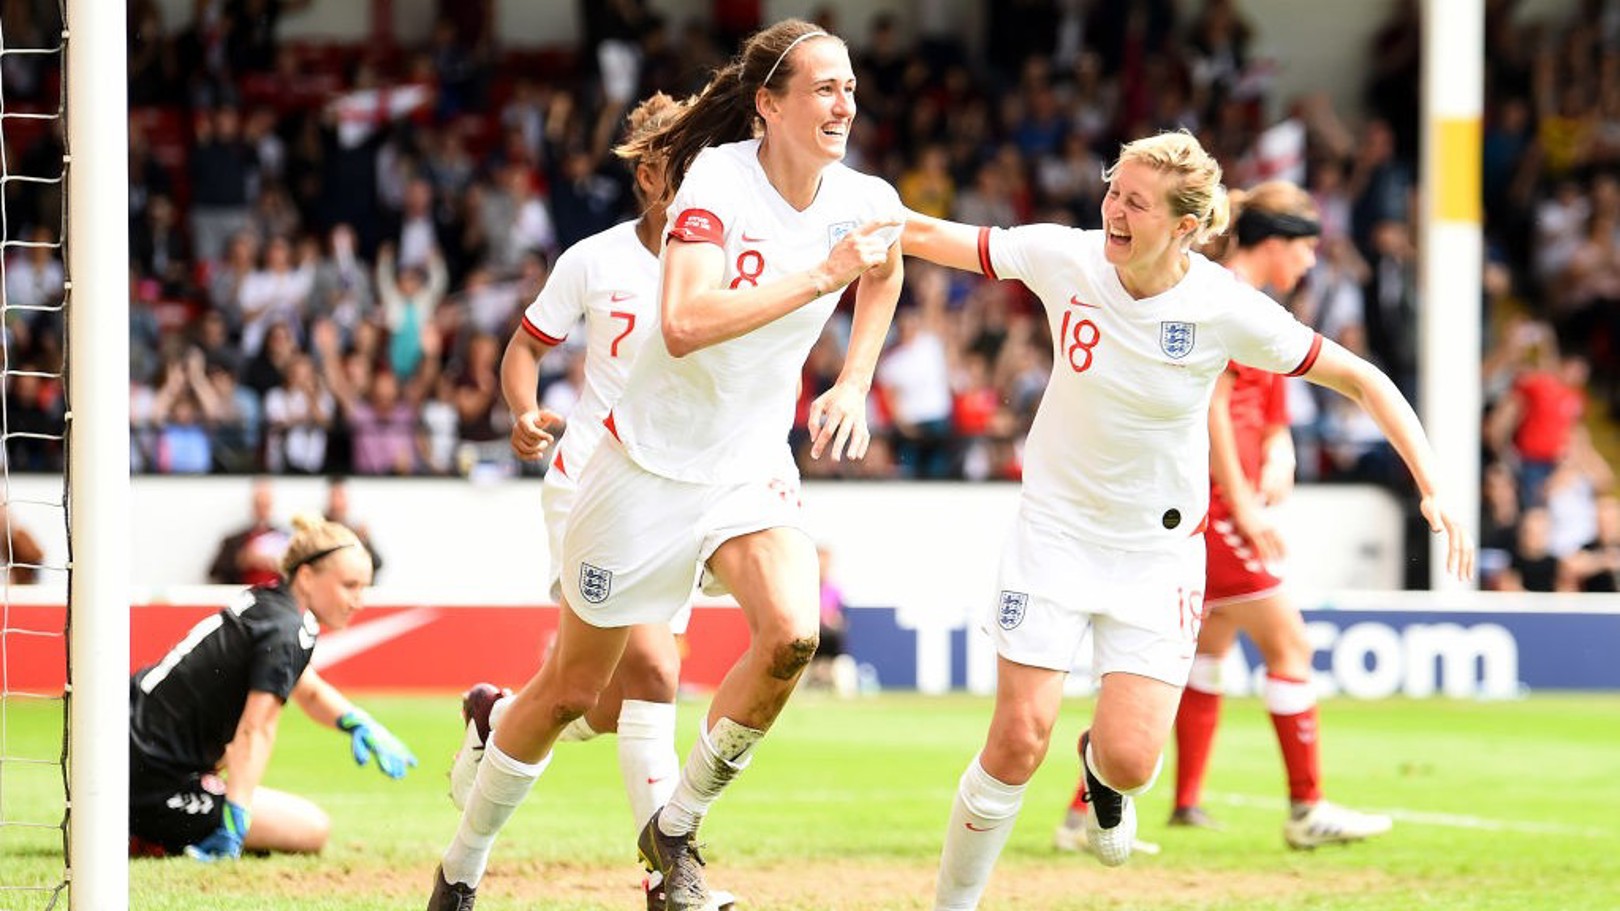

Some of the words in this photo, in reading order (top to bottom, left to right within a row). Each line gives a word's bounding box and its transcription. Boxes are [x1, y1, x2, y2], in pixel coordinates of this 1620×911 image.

[728, 249, 765, 290] 8
[609, 311, 636, 358] 7
[1060, 310, 1101, 373] 18
